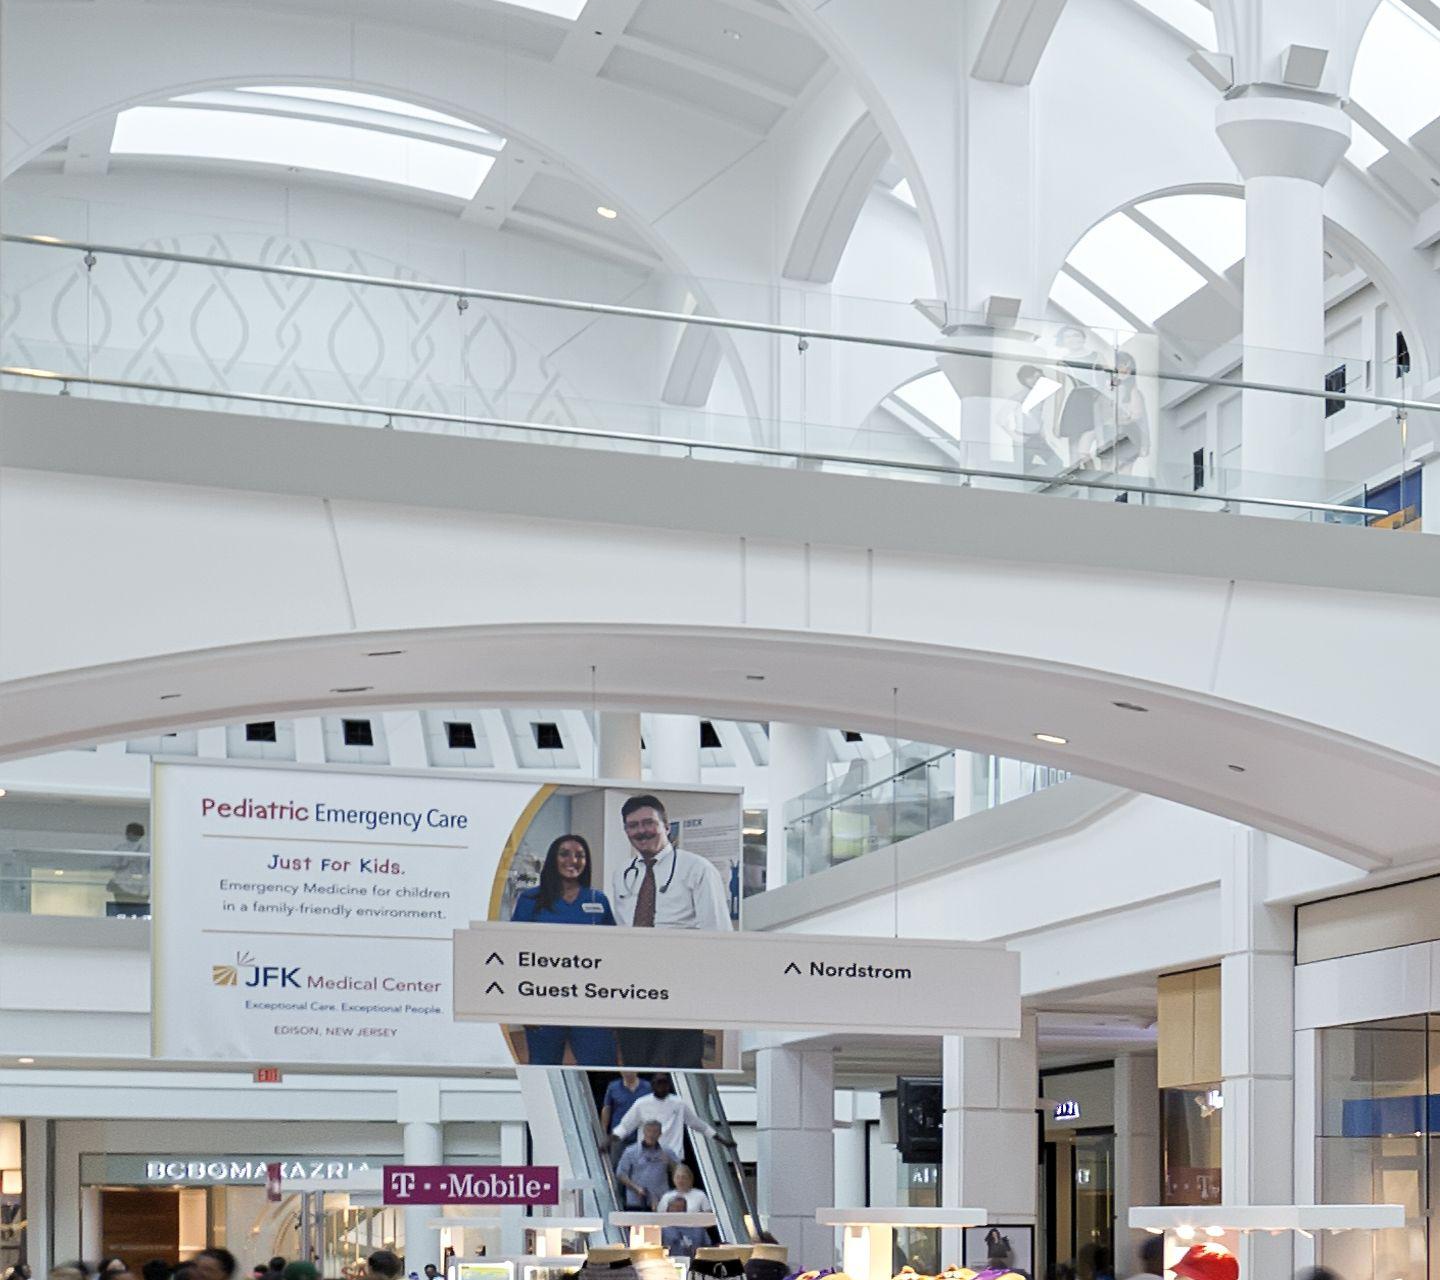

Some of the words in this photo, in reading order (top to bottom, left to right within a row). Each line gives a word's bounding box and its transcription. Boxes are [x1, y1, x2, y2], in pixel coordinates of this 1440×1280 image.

[202, 798, 310, 822] Pediatric
[315, 804, 422, 832] Emergency
[426, 809, 468, 830] Care
[267, 854, 312, 871] Just
[321, 858, 351, 872] For
[360, 858, 406, 875] Kids.
[220, 879, 299, 896] Emergency
[303, 883, 368, 897] Medicine
[372, 886, 392, 898] for
[395, 886, 451, 900] children
[222, 901, 235, 912] in
[239, 904, 249, 913] a
[252, 901, 353, 919] family-friendly
[356, 906, 447, 920] environment.
[518, 952, 602, 971] Elevator
[810, 961, 912, 980] Nordstrom
[245, 966, 302, 988] JFK
[307, 975, 377, 991] Medical
[382, 977, 442, 993] Center
[518, 981, 578, 1000] Guest
[584, 983, 669, 1002] Services
[245, 1000, 307, 1012] Exceptional
[341, 1002, 402, 1014] Exceptional
[274, 1026, 322, 1037] EDISON,
[326, 1026, 353, 1037] NEW
[356, 1027, 398, 1038] JERSEY
